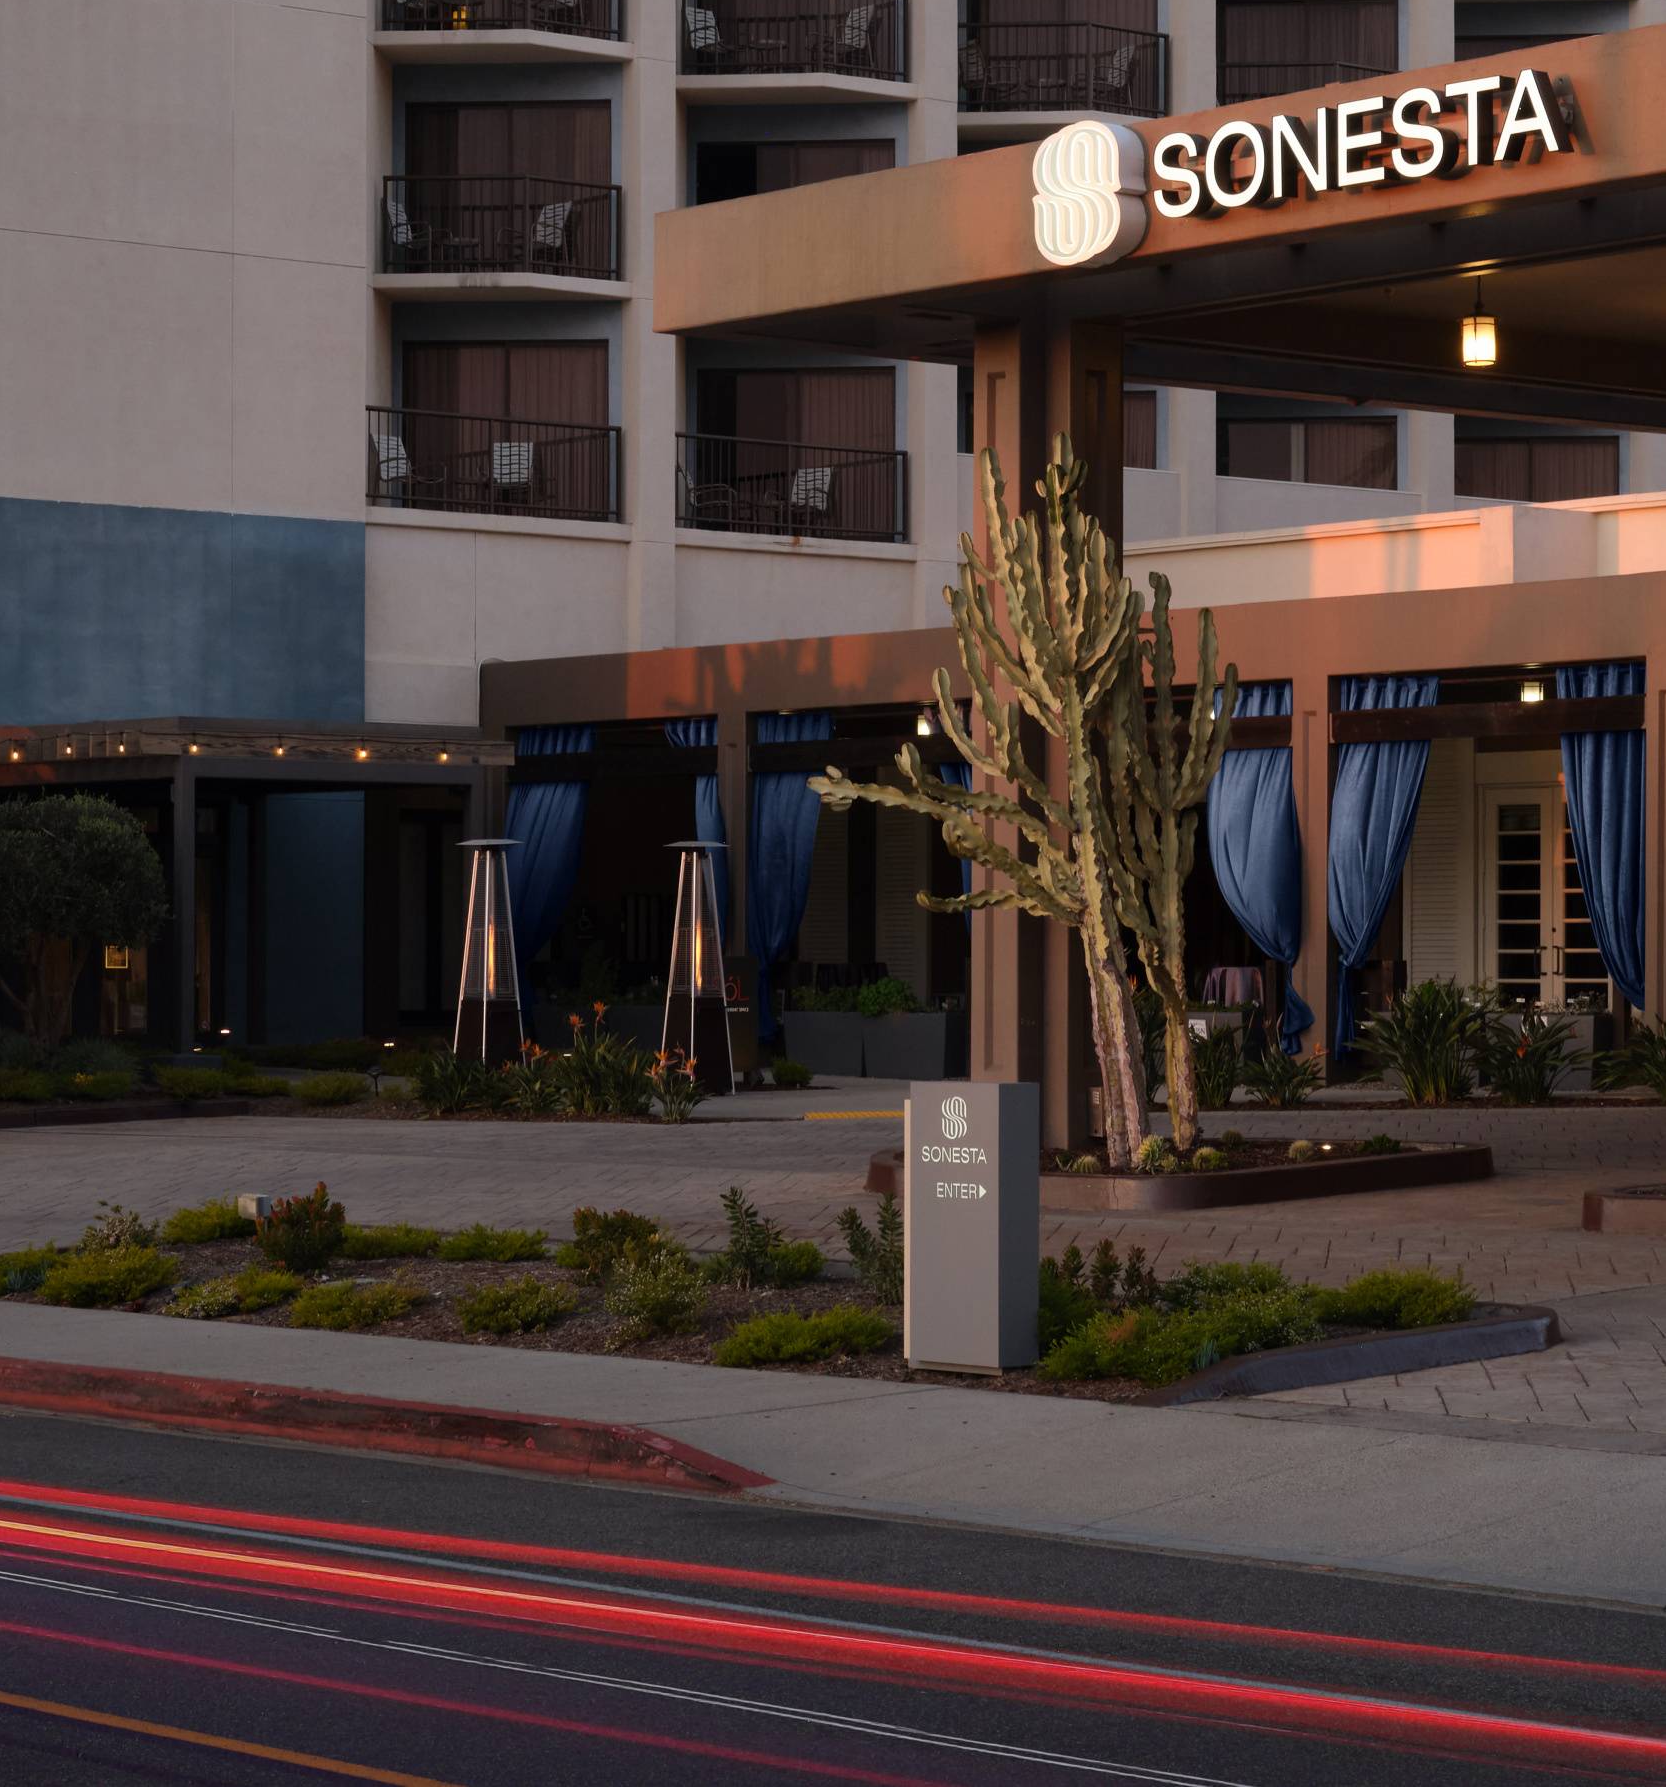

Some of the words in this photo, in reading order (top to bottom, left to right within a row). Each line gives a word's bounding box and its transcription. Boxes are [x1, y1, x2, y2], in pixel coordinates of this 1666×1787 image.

[1153, 67, 1561, 219] SONESTA
[921, 1145, 987, 1165] SONESTA
[936, 1182, 977, 1200] ENTER
